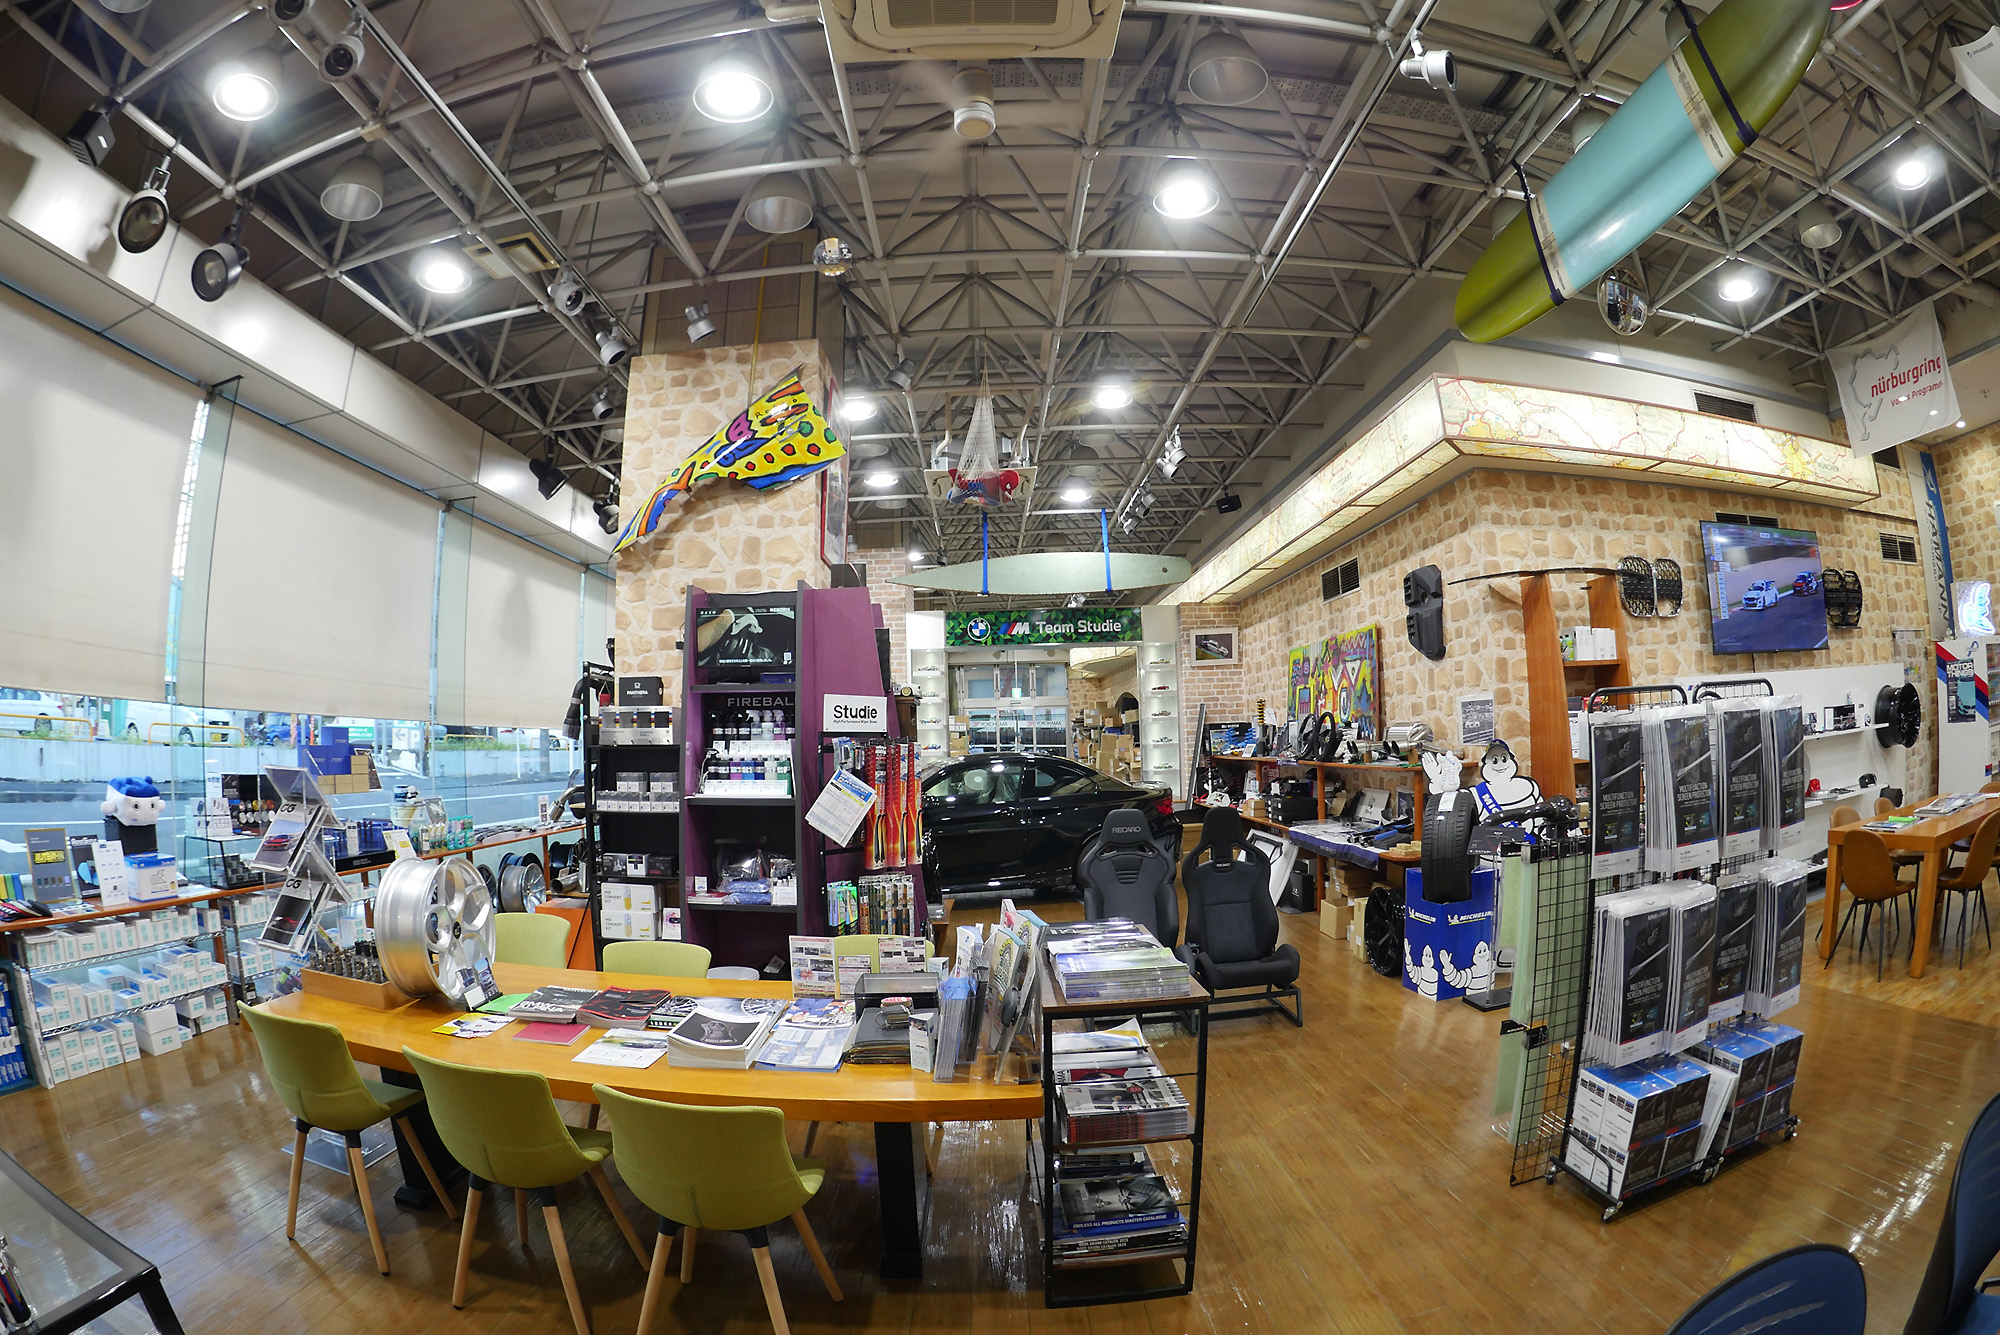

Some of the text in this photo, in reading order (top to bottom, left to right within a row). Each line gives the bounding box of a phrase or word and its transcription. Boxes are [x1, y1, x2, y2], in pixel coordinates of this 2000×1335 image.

[1871, 356, 1941, 397] nürburgring
[1926, 501, 1949, 622] HAMANN
[1036, 622, 1075, 634] Team
[1077, 620, 1122, 633] Studie
[1946, 662, 1974, 671] MOTOR
[834, 705, 878, 719] Studie
[1679, 782, 1708, 793] MULTIFUNCTION
[1677, 789, 1711, 801] SCREEN PROTECTOR
[280, 803, 296, 812] CG
[285, 879, 302, 889] CG
[1414, 912, 1437, 922] MICHELIN
[1459, 911, 1493, 921] MICHELIN
[1143, 1214, 1167, 1222] CATALOGUE
